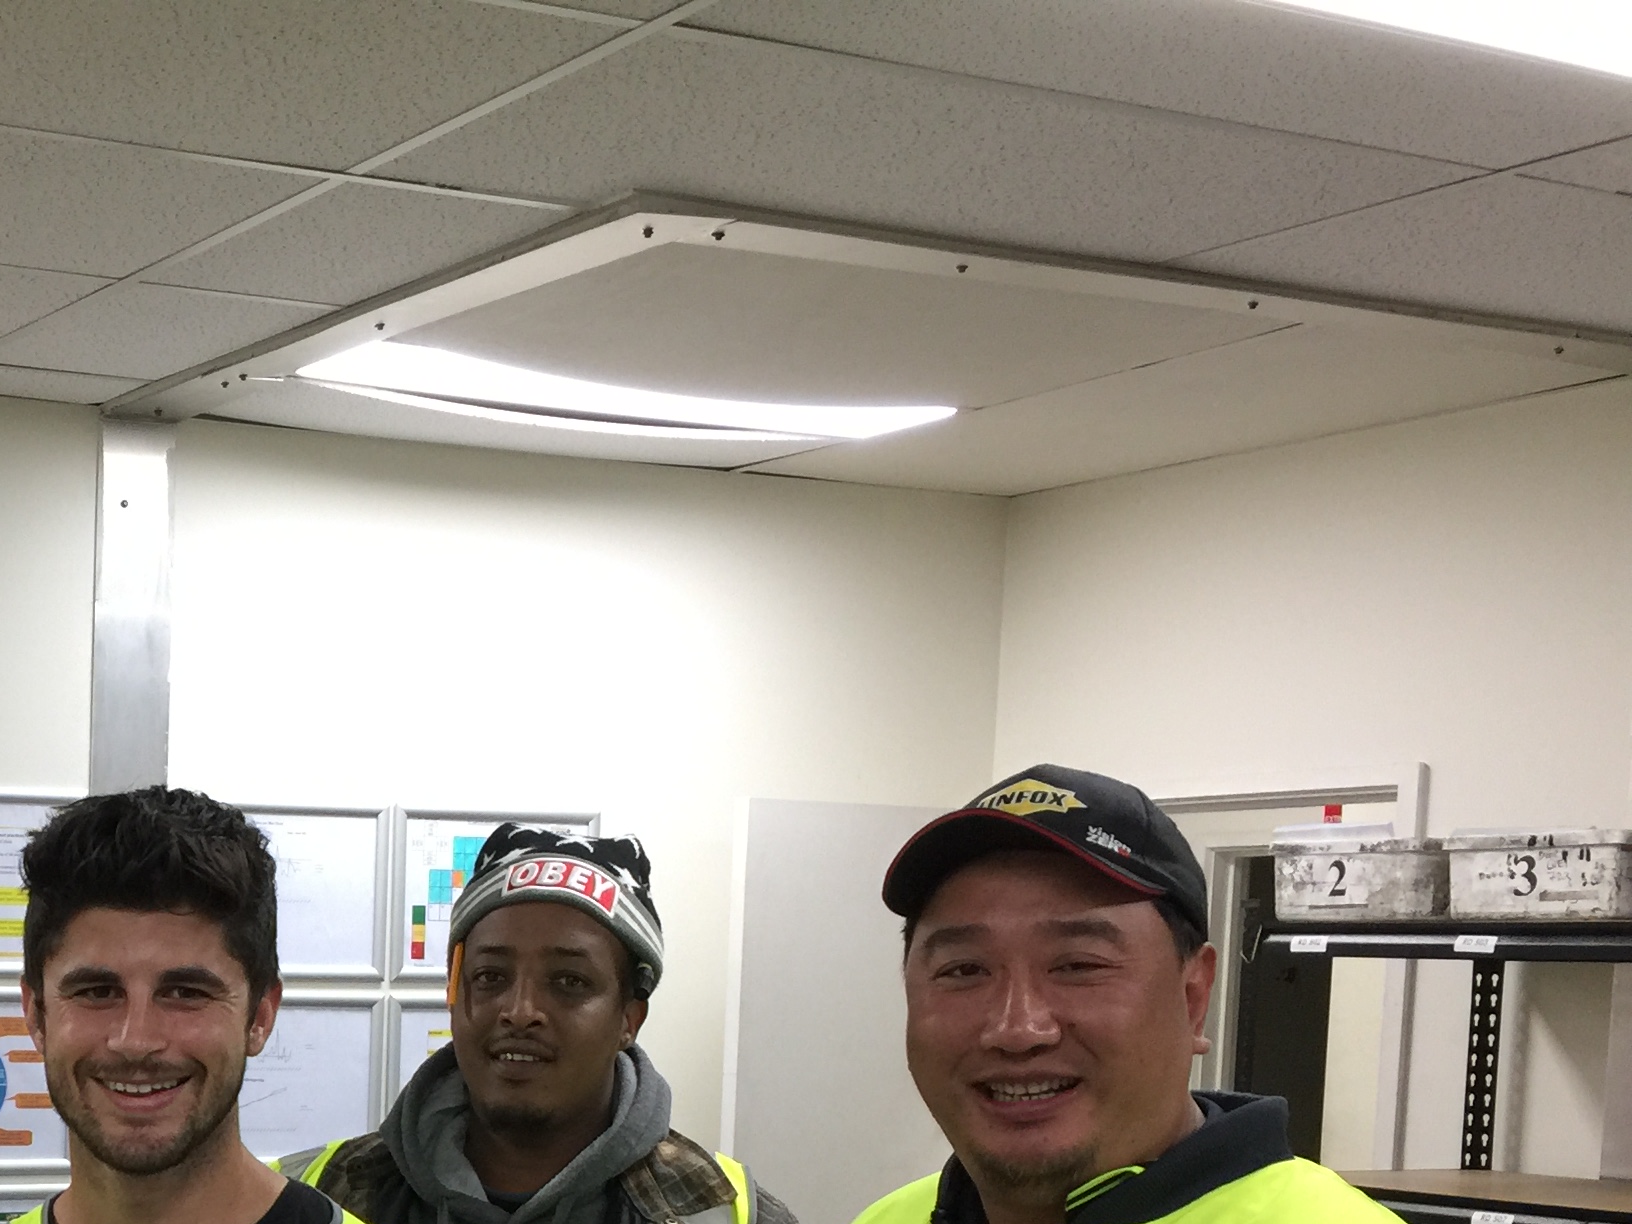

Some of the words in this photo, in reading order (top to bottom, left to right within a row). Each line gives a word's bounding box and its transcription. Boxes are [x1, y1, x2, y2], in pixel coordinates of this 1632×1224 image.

[510, 862, 615, 900] OBEY
[1328, 859, 1347, 897] 2
[1513, 855, 1537, 896] 3
